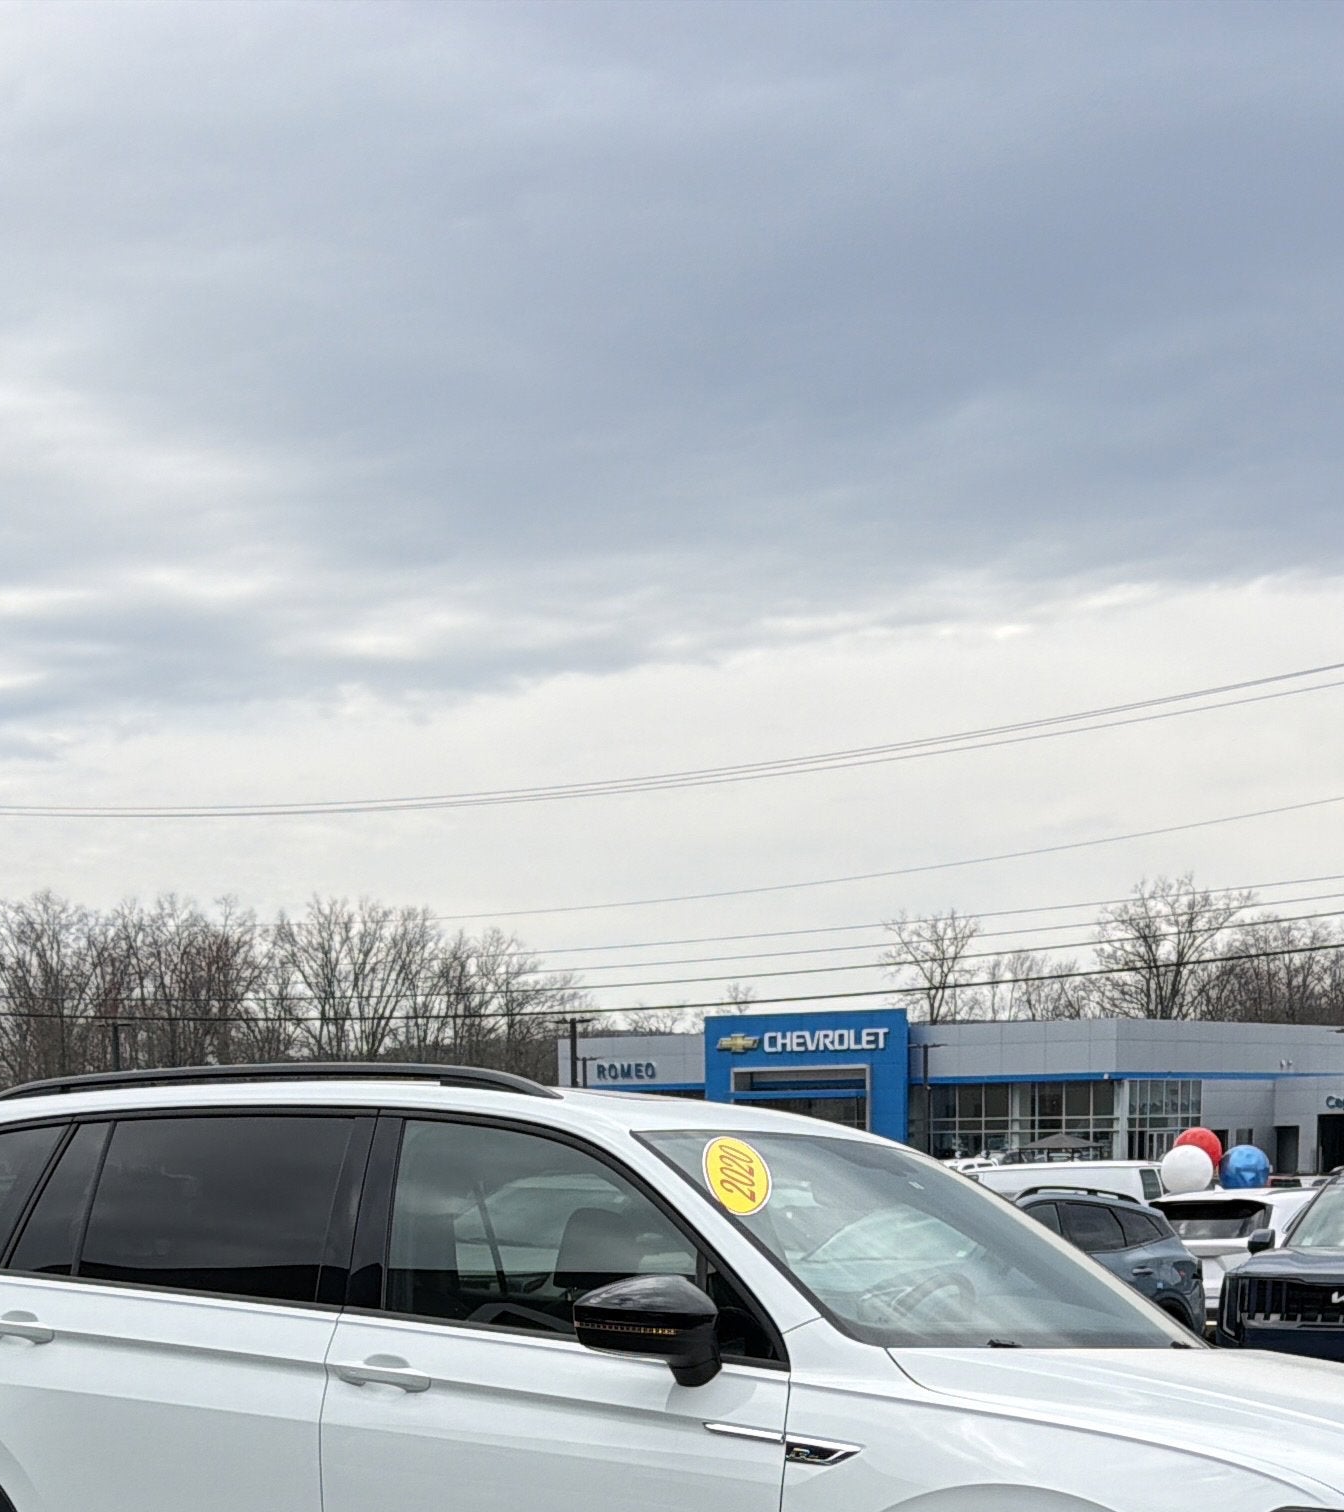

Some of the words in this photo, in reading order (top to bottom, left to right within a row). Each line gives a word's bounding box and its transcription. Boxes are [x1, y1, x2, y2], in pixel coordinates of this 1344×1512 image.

[763, 1027, 889, 1053] CHEVROLET
[596, 1062, 657, 1080] ROMEO
[718, 1144, 756, 1203] 2020
